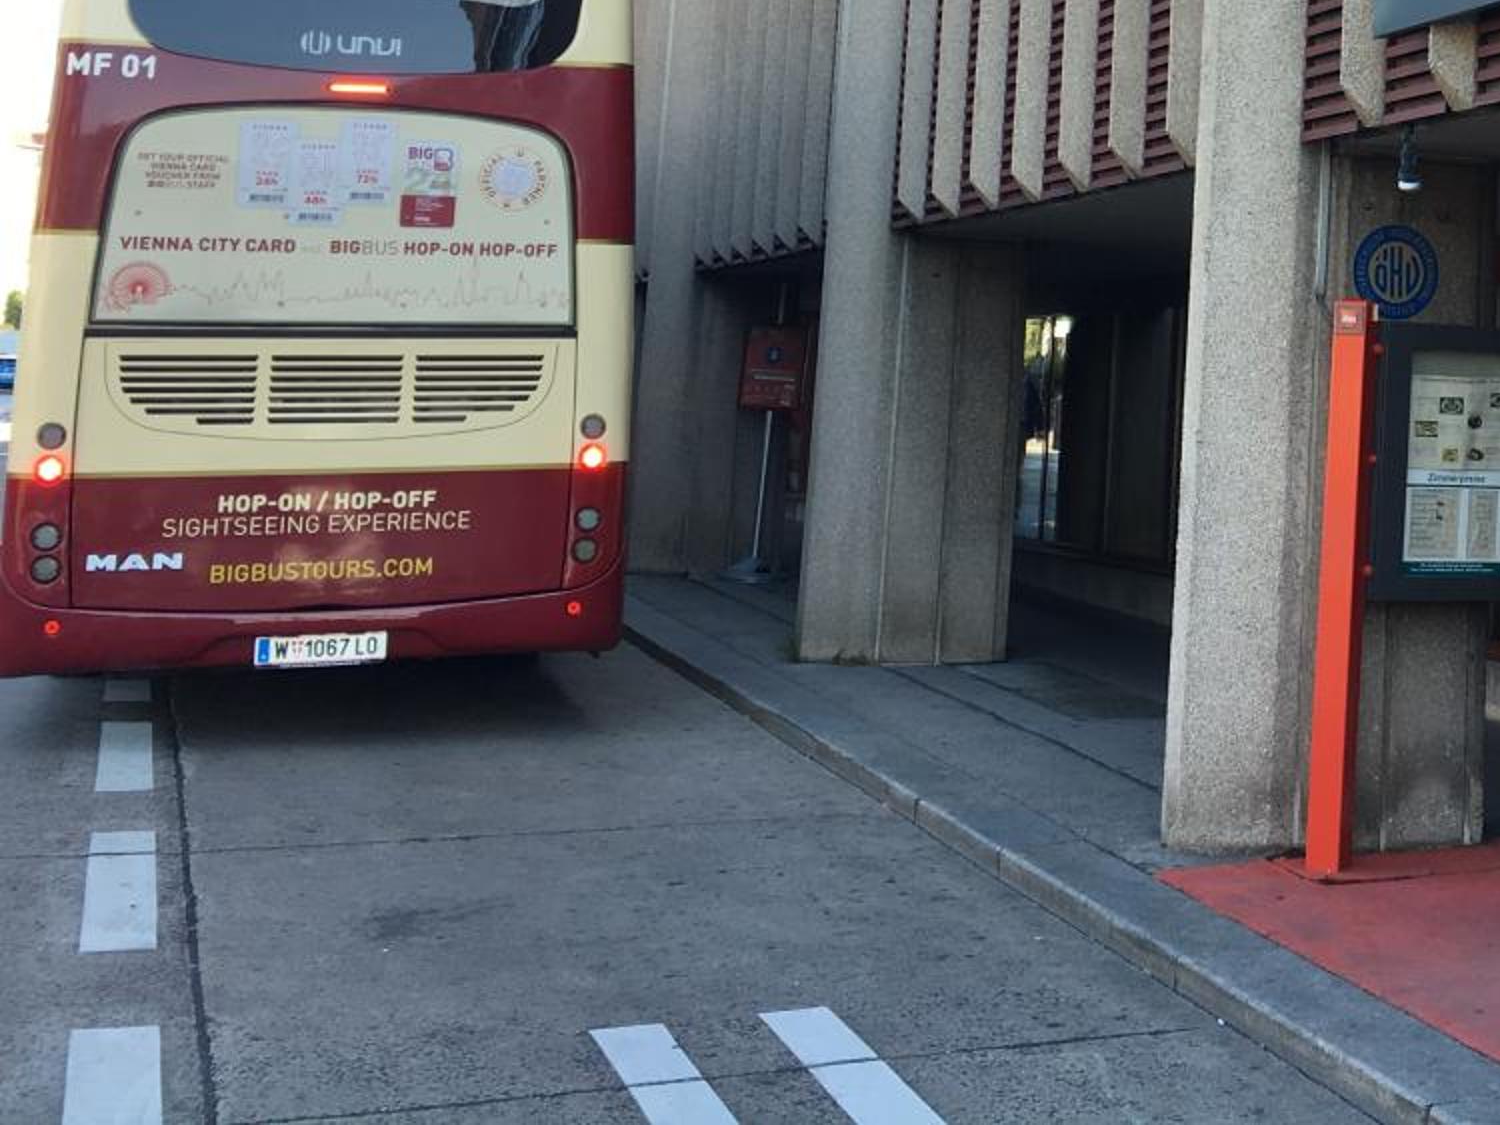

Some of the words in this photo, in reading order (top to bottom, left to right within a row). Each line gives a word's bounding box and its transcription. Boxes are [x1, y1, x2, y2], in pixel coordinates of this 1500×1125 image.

[66, 52, 113, 77] MF
[121, 53, 157, 79] 01
[120, 236, 194, 253] VIENNA
[199, 237, 241, 253] CITY
[245, 238, 296, 253] CARD
[330, 240, 399, 256] BIGBUS
[404, 241, 474, 257] HOP-ON
[480, 242, 558, 258] HOP-OFF
[217, 493, 311, 513] HOP-ON
[316, 491, 326, 512] /
[334, 490, 437, 510] HOP-OFF
[162, 515, 320, 538] SIGHTSEEING
[328, 510, 471, 533] EXPERIENCE
[85, 552, 184, 572] MAN
[210, 557, 433, 584] BIGBUSTOURS.COM
[275, 640, 289, 659] W
[304, 638, 350, 658] 1067
